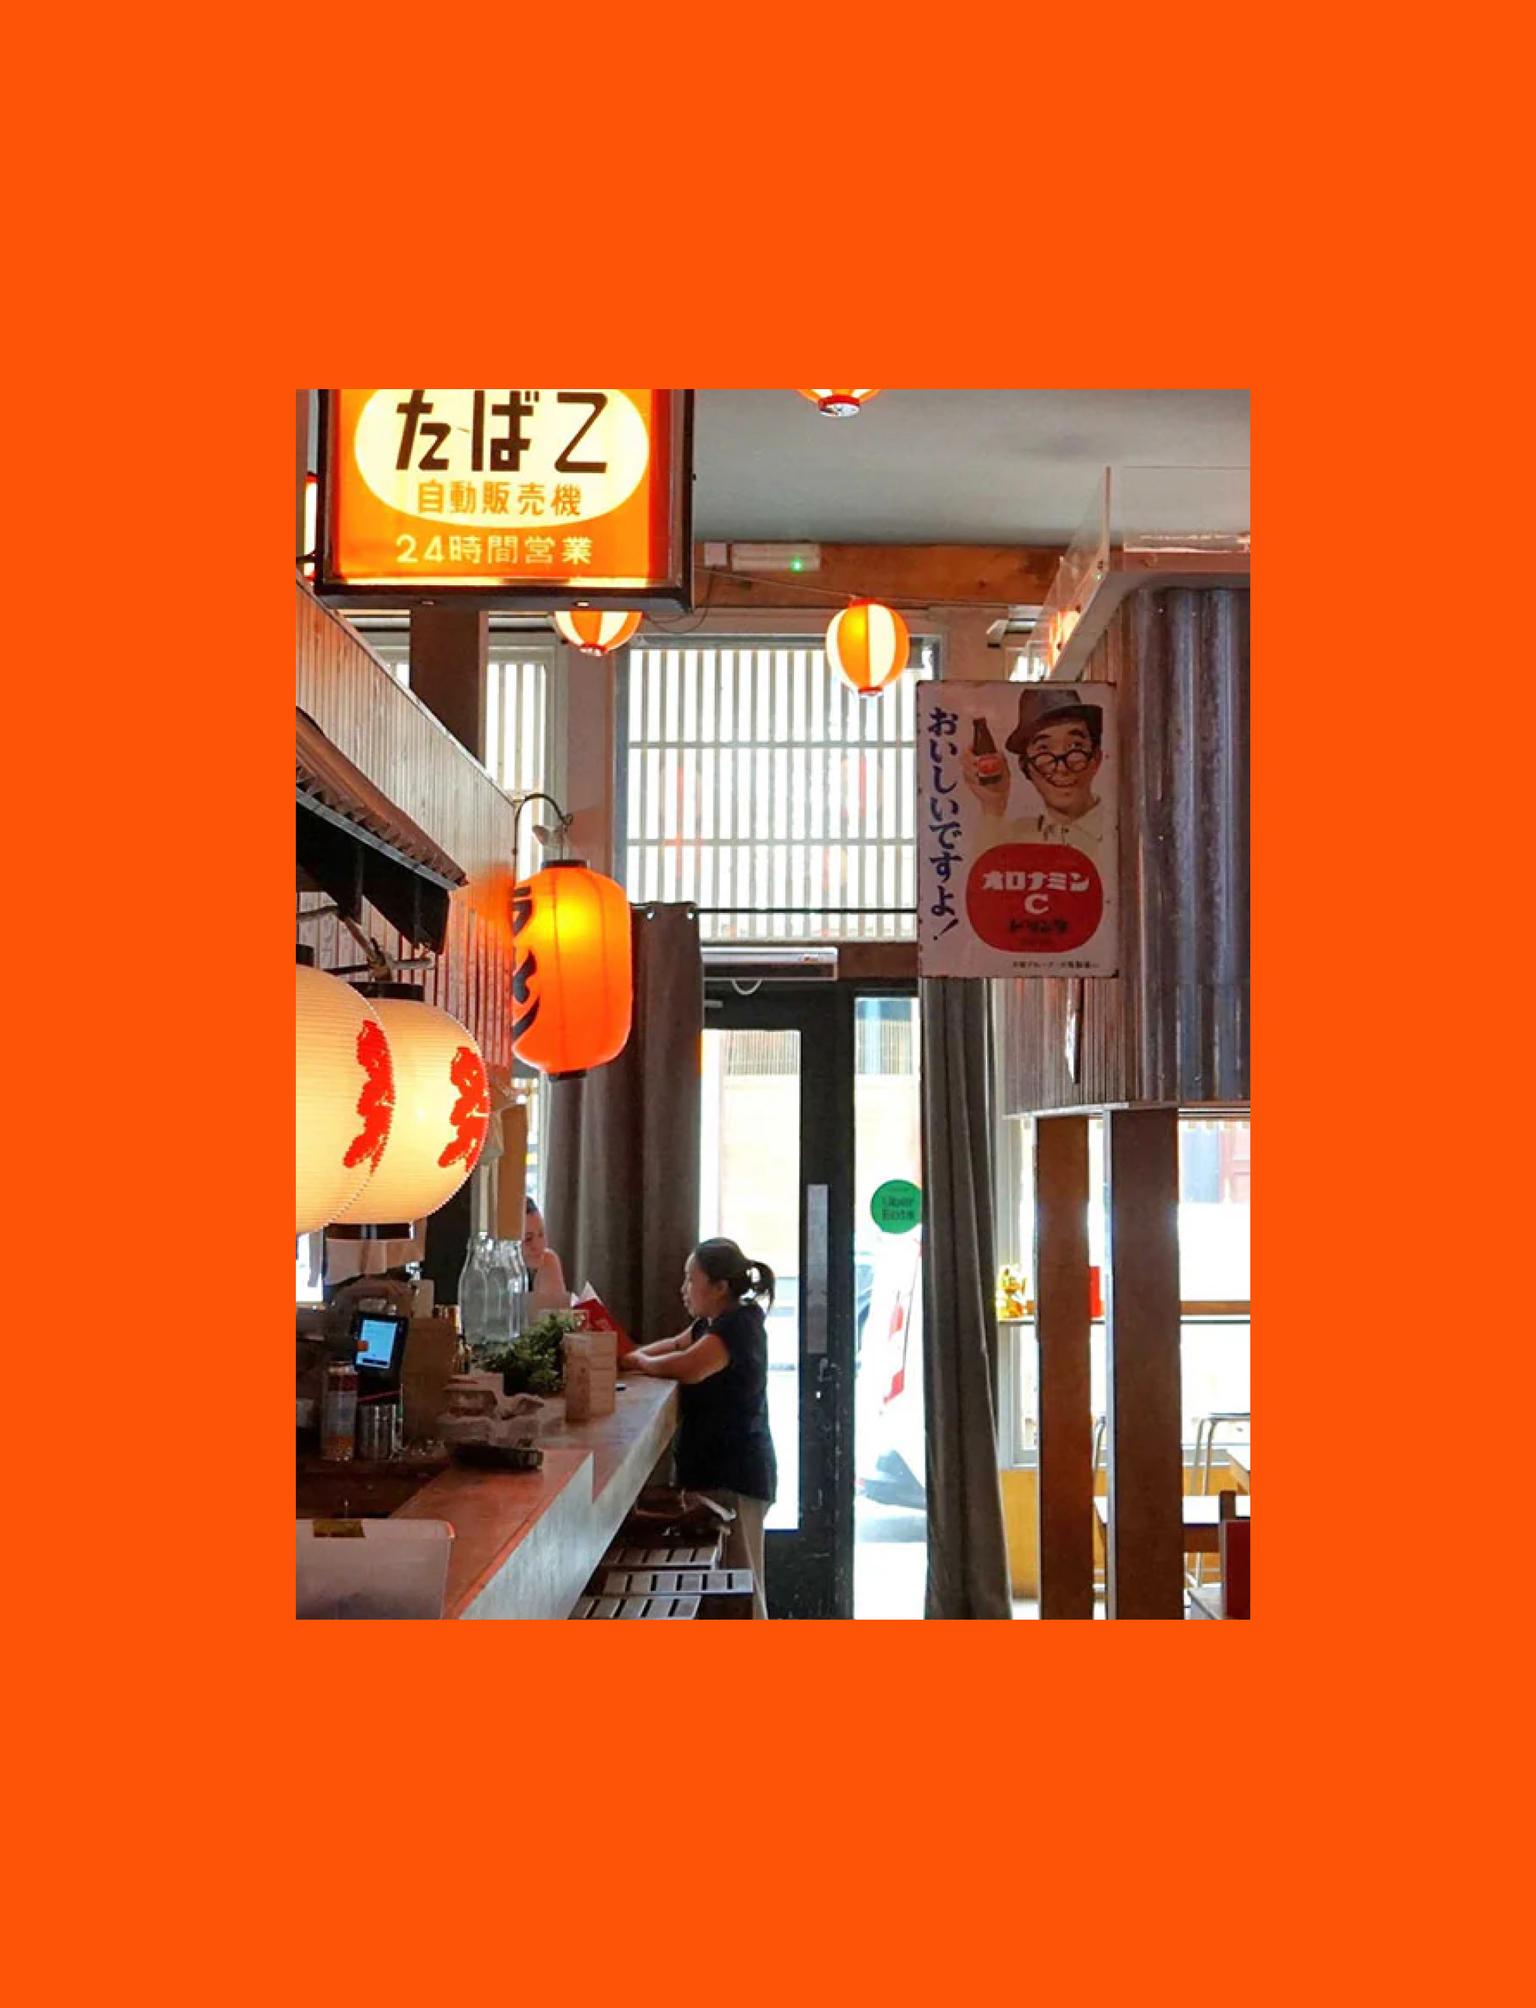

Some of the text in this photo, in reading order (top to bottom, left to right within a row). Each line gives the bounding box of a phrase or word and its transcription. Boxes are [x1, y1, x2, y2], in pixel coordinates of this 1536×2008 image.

[396, 389, 608, 474] たばこ
[417, 479, 582, 516] 自動販売機
[395, 533, 593, 565] 24時間営業
[927, 706, 963, 942] おいしいですよ！
[981, 869, 1090, 892] オロナミン
[1024, 893, 1049, 915] C
